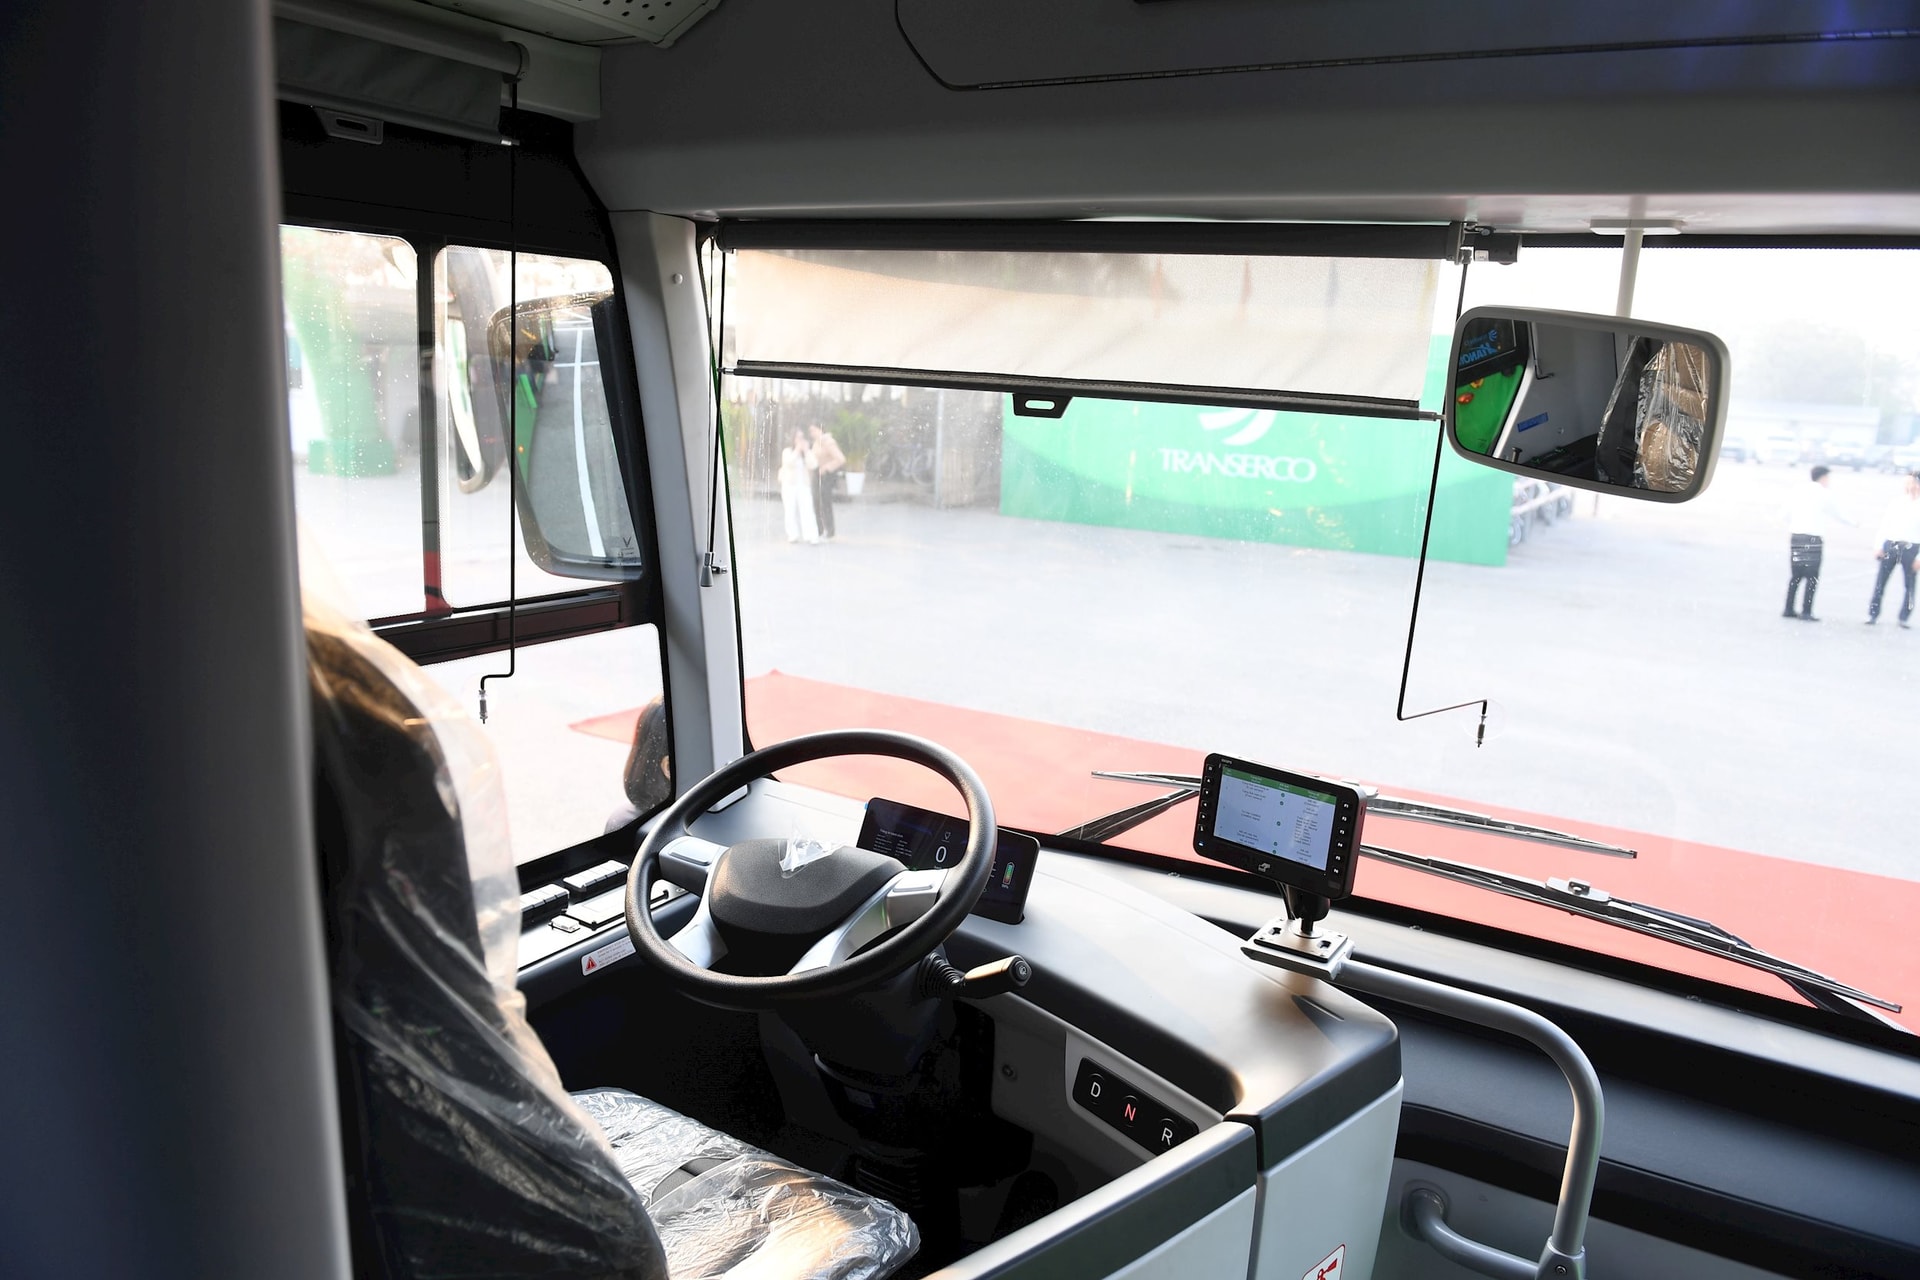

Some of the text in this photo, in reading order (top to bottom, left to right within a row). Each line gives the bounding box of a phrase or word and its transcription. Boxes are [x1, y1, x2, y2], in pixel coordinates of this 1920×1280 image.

[1156, 447, 1318, 483] TRANSERCO
[935, 846, 947, 863] 0
[1090, 1081, 1173, 1146] D N R
